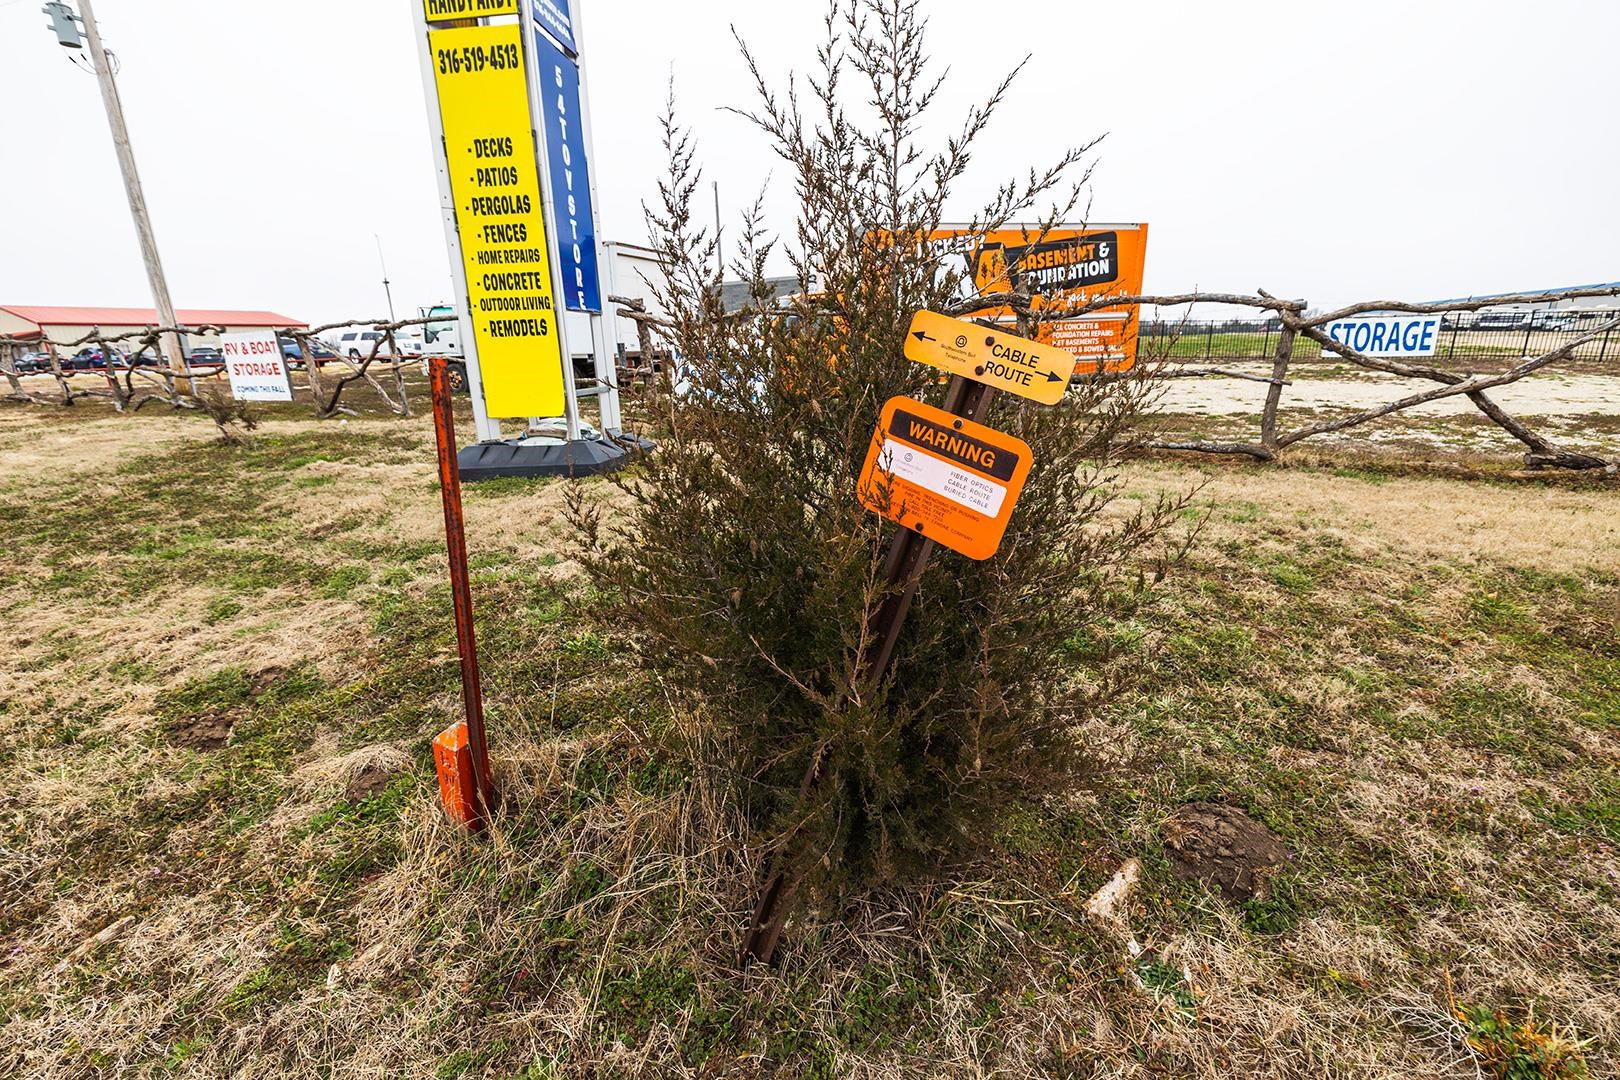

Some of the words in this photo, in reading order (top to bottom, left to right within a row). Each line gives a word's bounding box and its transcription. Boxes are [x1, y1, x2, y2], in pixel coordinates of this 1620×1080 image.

[438, 43, 519, 74] 316-519-4513
[473, 136, 513, 158] DECKS
[476, 166, 518, 187] PATIOS
[471, 194, 531, 216] PERGOLAS
[482, 223, 527, 243] FENCES
[477, 250, 503, 265] HOME
[504, 248, 540, 264] REPAIRS
[1099, 242, 1110, 258] &
[483, 272, 542, 291] CONCRETE
[480, 297, 521, 311] OUTDOOR
[522, 296, 551, 310] LIVING
[489, 318, 548, 338] REMODELS
[1064, 322, 1094, 331] CONCRETE
[1091, 329, 1114, 337] REPAIRS
[1328, 321, 1436, 352] STORAGE
[224, 342, 238, 355] RV
[241, 342, 249, 355] &
[249, 340, 276, 355] BOAT
[1065, 337, 1099, 346] BASEMENTS
[992, 344, 1040, 369] CABLE
[233, 362, 281, 376] STORAGE
[984, 361, 1034, 386] ROUTE
[909, 420, 996, 469] WARNING
[947, 478, 967, 491] CABLE
[970, 487, 991, 501] ROUTE
[950, 471, 968, 482] FIBER
[970, 479, 994, 494] OPTICS
[943, 485, 967, 499] BURIED
[968, 496, 989, 509] CABLE
